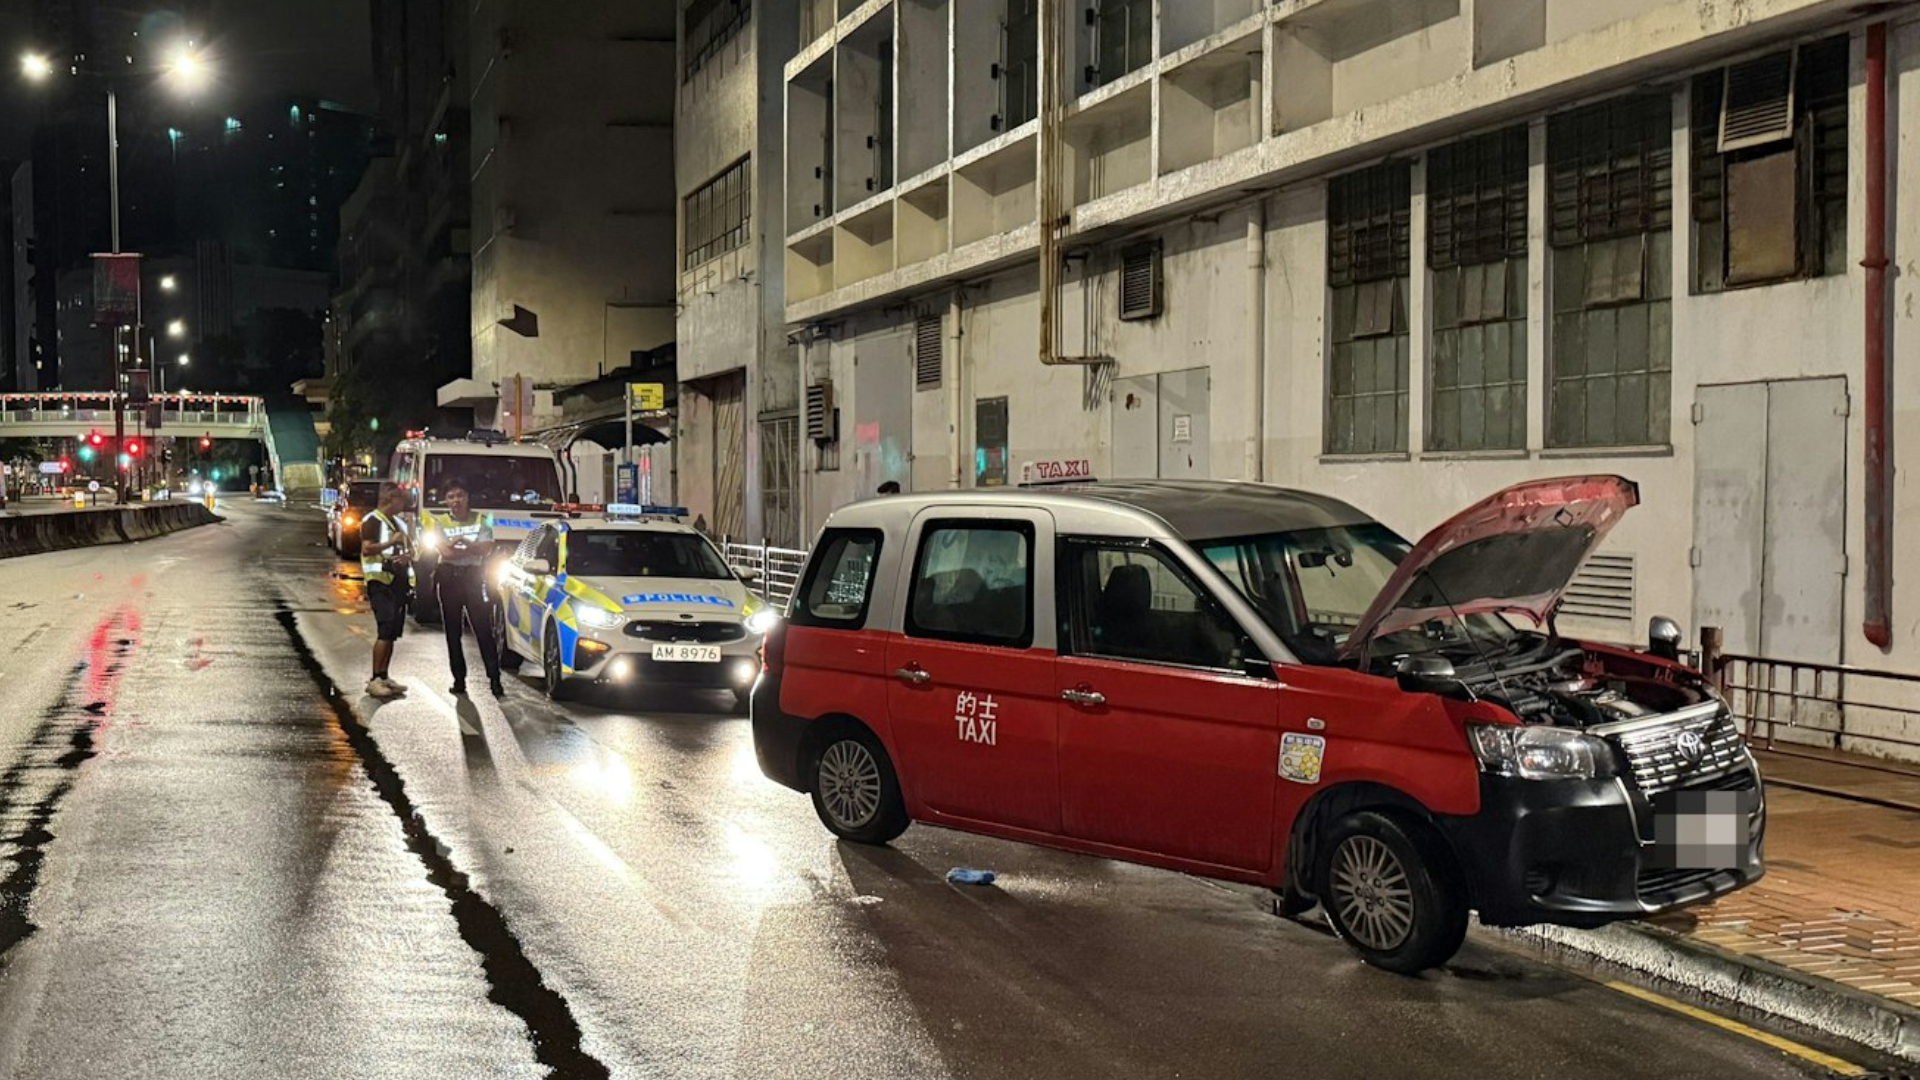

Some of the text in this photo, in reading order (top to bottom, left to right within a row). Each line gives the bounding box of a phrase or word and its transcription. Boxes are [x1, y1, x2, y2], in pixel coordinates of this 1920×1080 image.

[1037, 460, 1089, 478] TAXI
[644, 593, 713, 604] POLICE
[656, 646, 717, 660] AM 8976
[956, 690, 998, 719] 的士
[954, 715, 996, 746] TAXI
